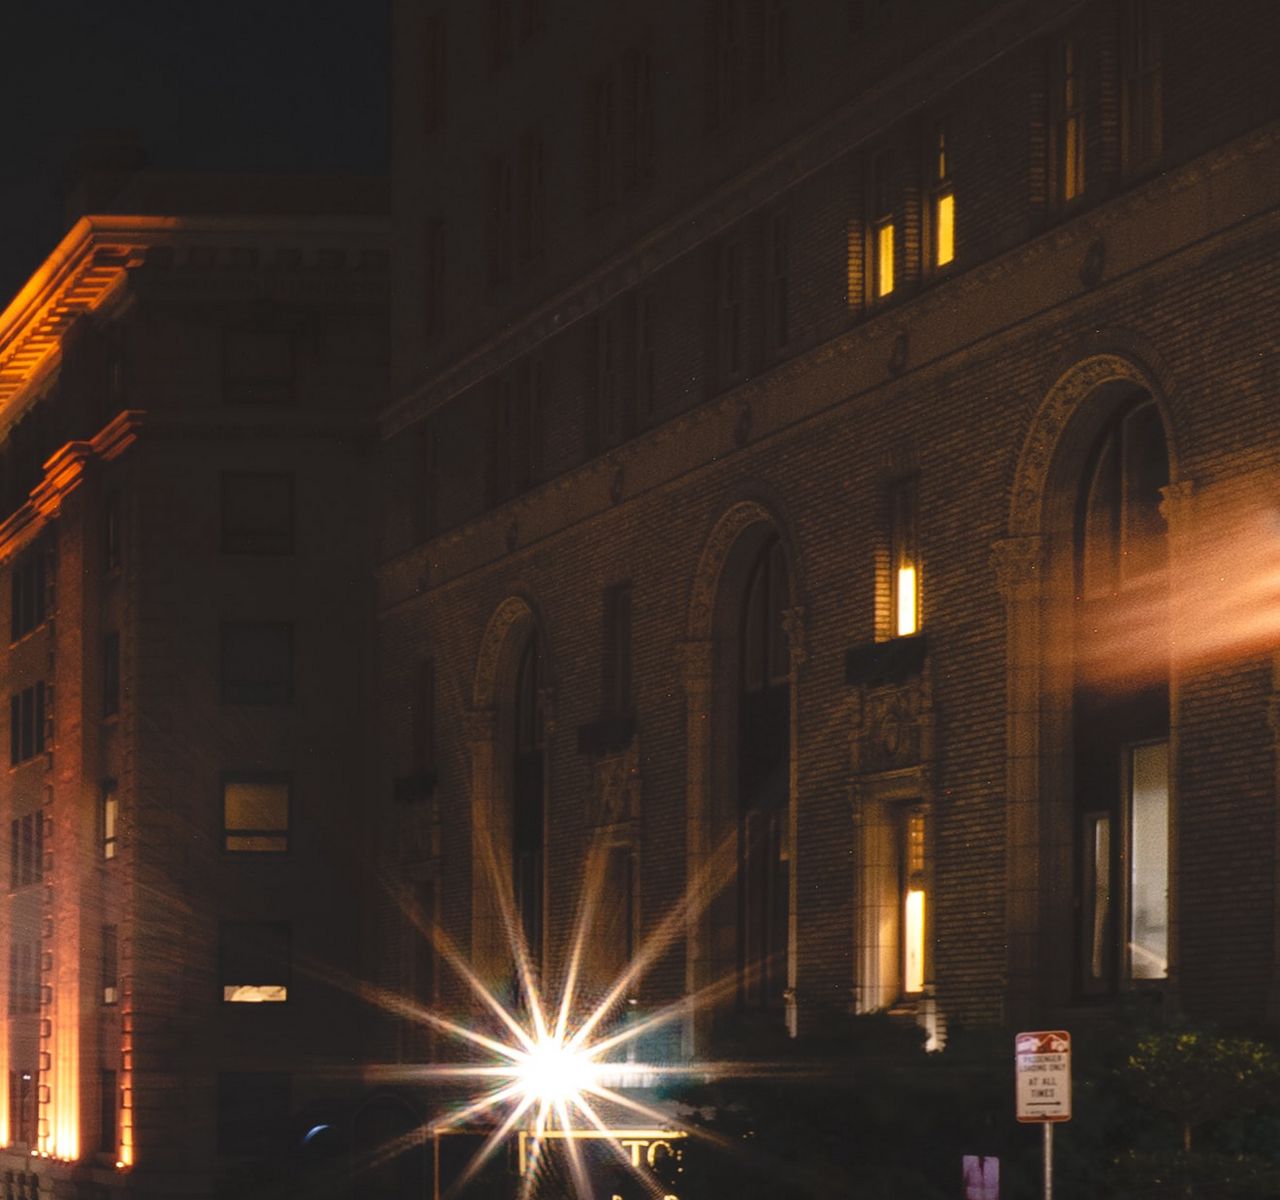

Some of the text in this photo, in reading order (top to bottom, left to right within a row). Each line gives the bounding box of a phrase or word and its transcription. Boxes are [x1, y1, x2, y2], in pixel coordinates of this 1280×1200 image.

[1028, 1077, 1057, 1086] AT ALL
[1031, 1088, 1056, 1098] TIMES
